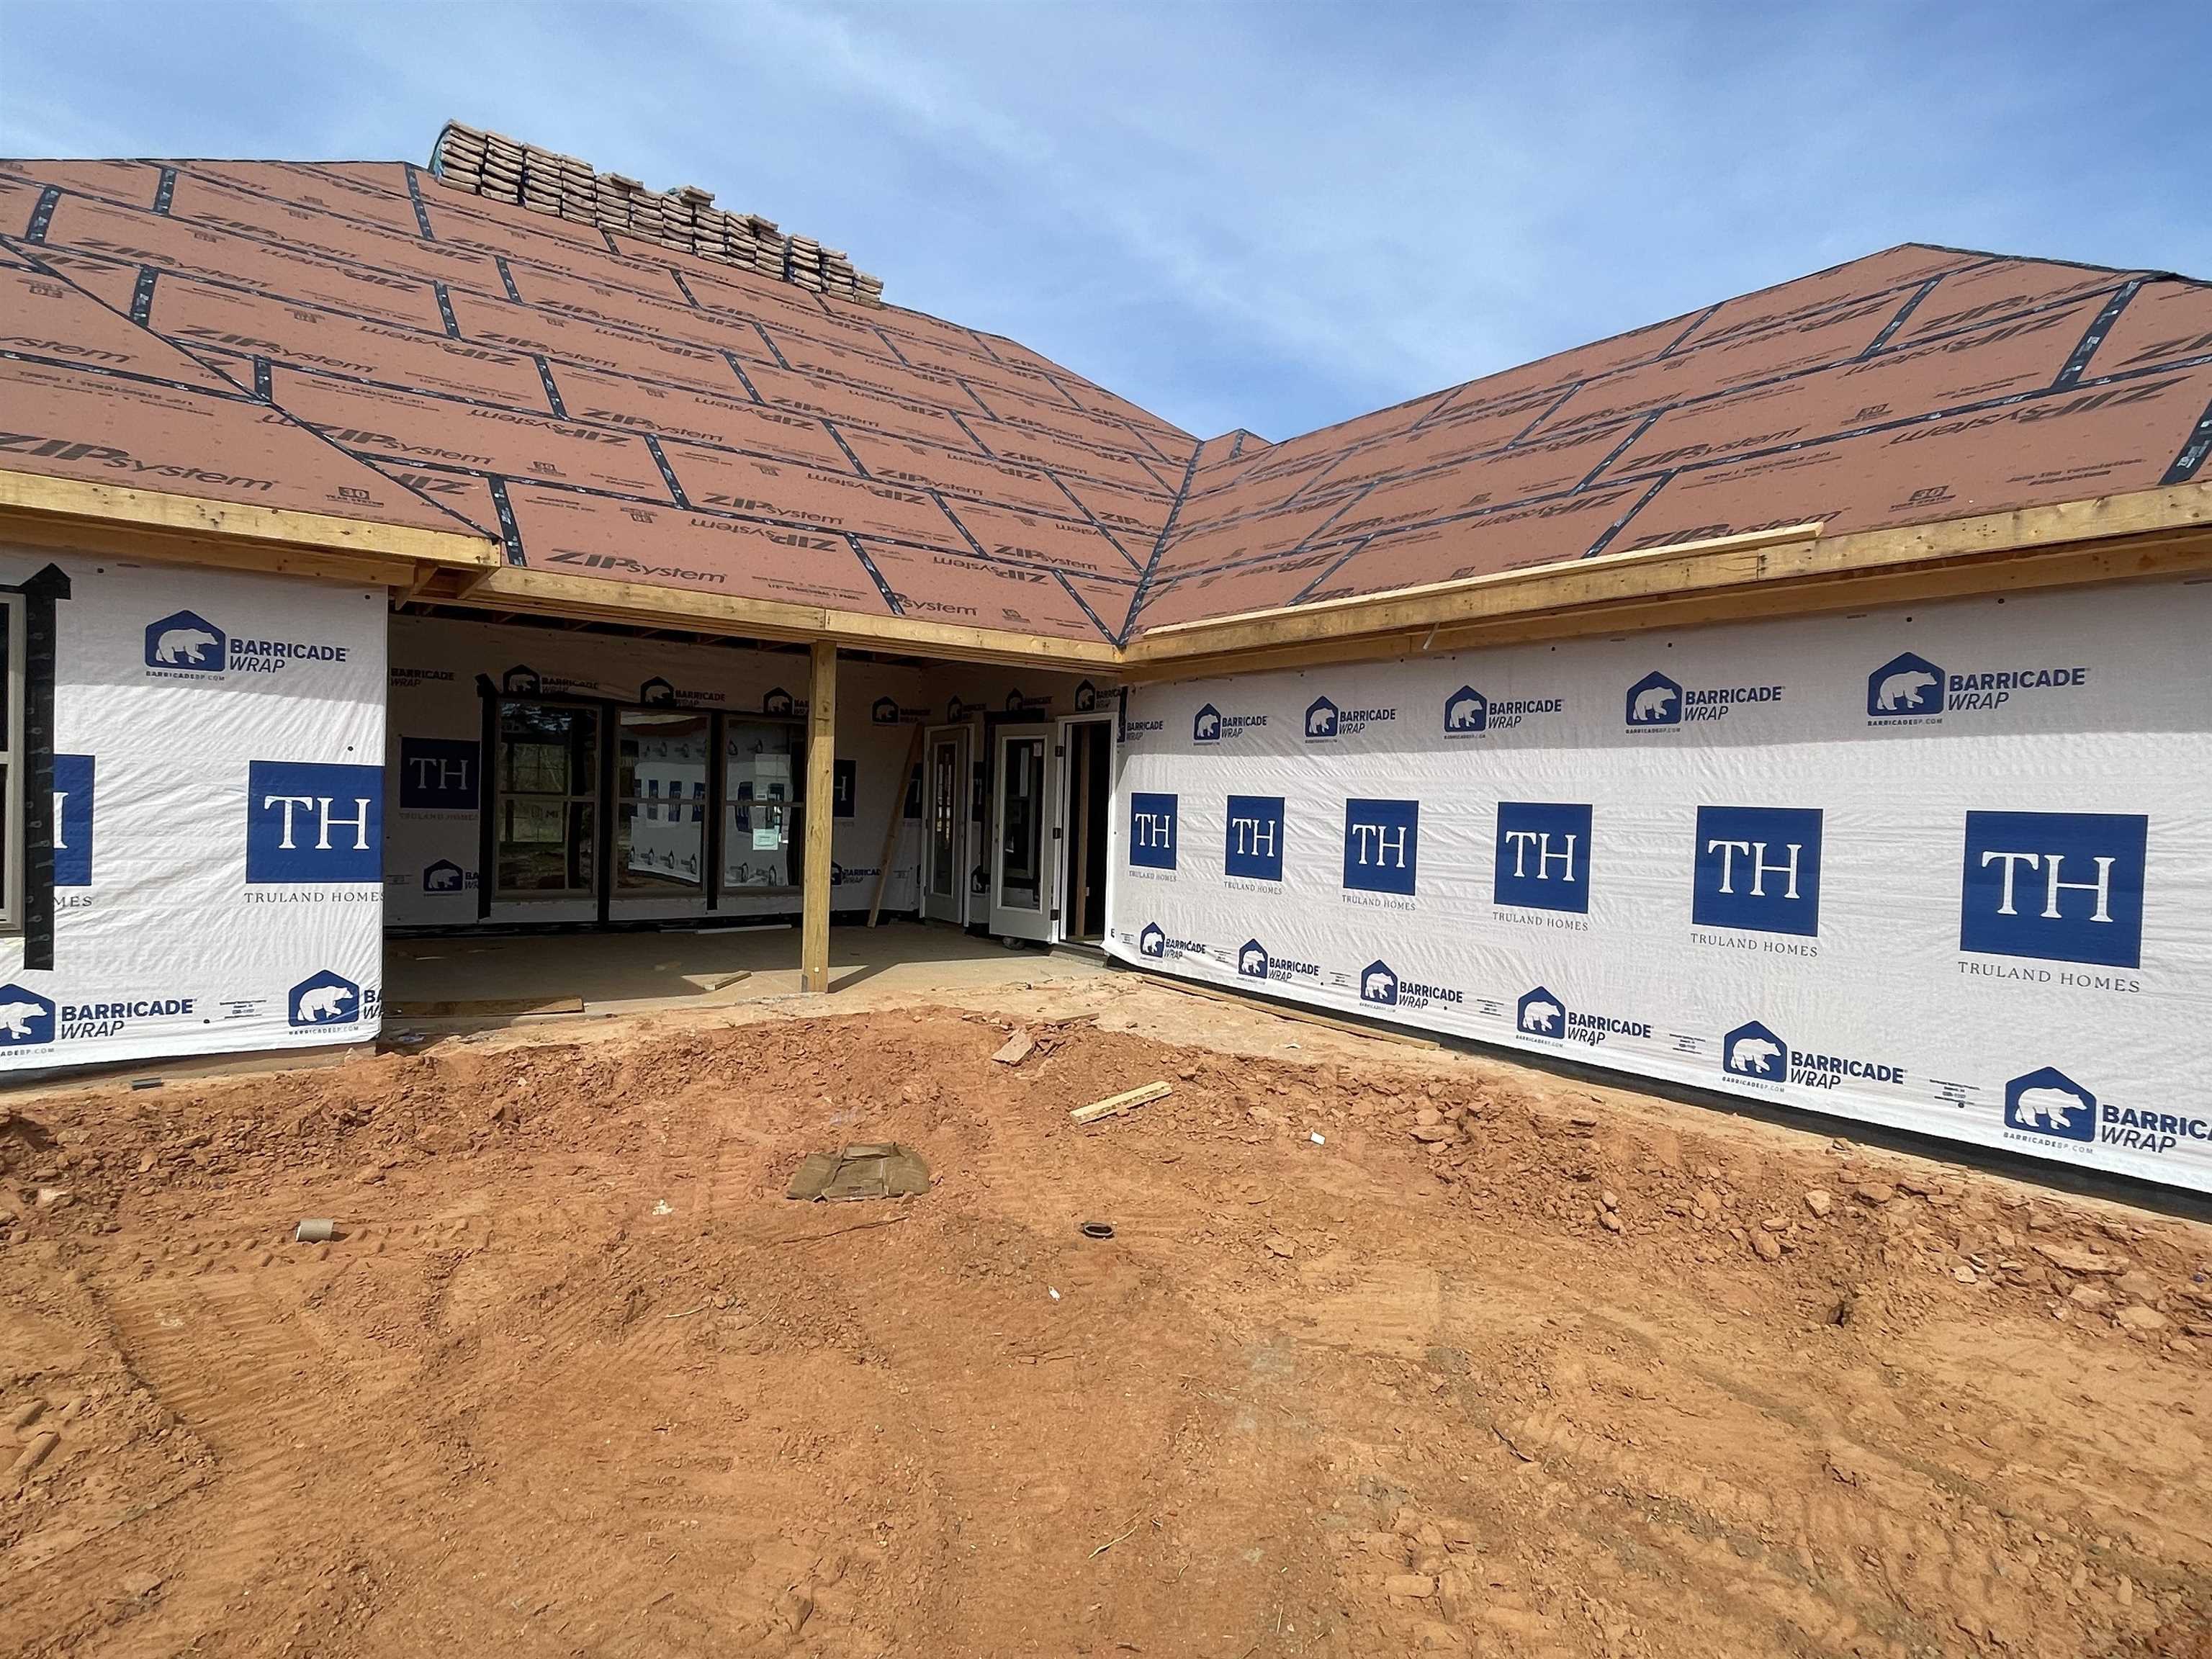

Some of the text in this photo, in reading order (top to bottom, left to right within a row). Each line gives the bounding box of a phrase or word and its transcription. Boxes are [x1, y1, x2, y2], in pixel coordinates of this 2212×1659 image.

[230, 638, 346, 662] BARRICADE
[230, 655, 285, 674] WRAP
[391, 667, 455, 681] BARRICADE
[1948, 668, 2086, 691] BARRICADE
[1685, 686, 1782, 705] BARRICADE
[1948, 692, 2009, 711] WRAP
[1339, 709, 1396, 722] BARRICADE
[1489, 698, 1562, 716] BARRICADE
[1684, 706, 1729, 722] WRAP
[1126, 721, 1164, 732] BARRICADE
[1222, 716, 1267, 728] BARRICADE
[1339, 722, 1365, 735] WRAP
[1488, 716, 1521, 729] WRAP
[1221, 728, 1244, 739] WRAP
[409, 757, 468, 791] TH
[264, 796, 371, 850] TH
[1135, 813, 1170, 848] TH
[1232, 818, 1274, 858] TH
[1352, 824, 1406, 868] TH
[1505, 831, 1576, 882] TH
[1707, 840, 1802, 899] TH
[1224, 881, 1282, 895] TRULAND HOMES
[1982, 850, 2116, 923] TH
[244, 892, 325, 904] TRULAND
[1342, 895, 1416, 911] TRULAND HOMES
[1493, 912, 1588, 932] TRULAND HOMES
[1166, 938, 1205, 954] BARRICADE
[1691, 933, 1818, 958] TRULAND HOMES
[1269, 958, 1319, 976] BARRICADE
[1269, 968, 1292, 981] WRAP
[1958, 961, 2141, 994] TRULAND HOMES
[1398, 994, 1429, 1010] WRAP
[1399, 981, 1463, 1004] BARRICADE
[61, 999, 193, 1022] BARRICADE
[60, 1020, 124, 1040] WRAP
[1568, 1012, 1652, 1039] BARRICADE
[1567, 1028, 1606, 1046] WRAP
[1791, 1051, 1905, 1085] BARRICADE
[1790, 1066, 1841, 1090] WRAP
[2102, 1124, 2177, 1154] WRAP
